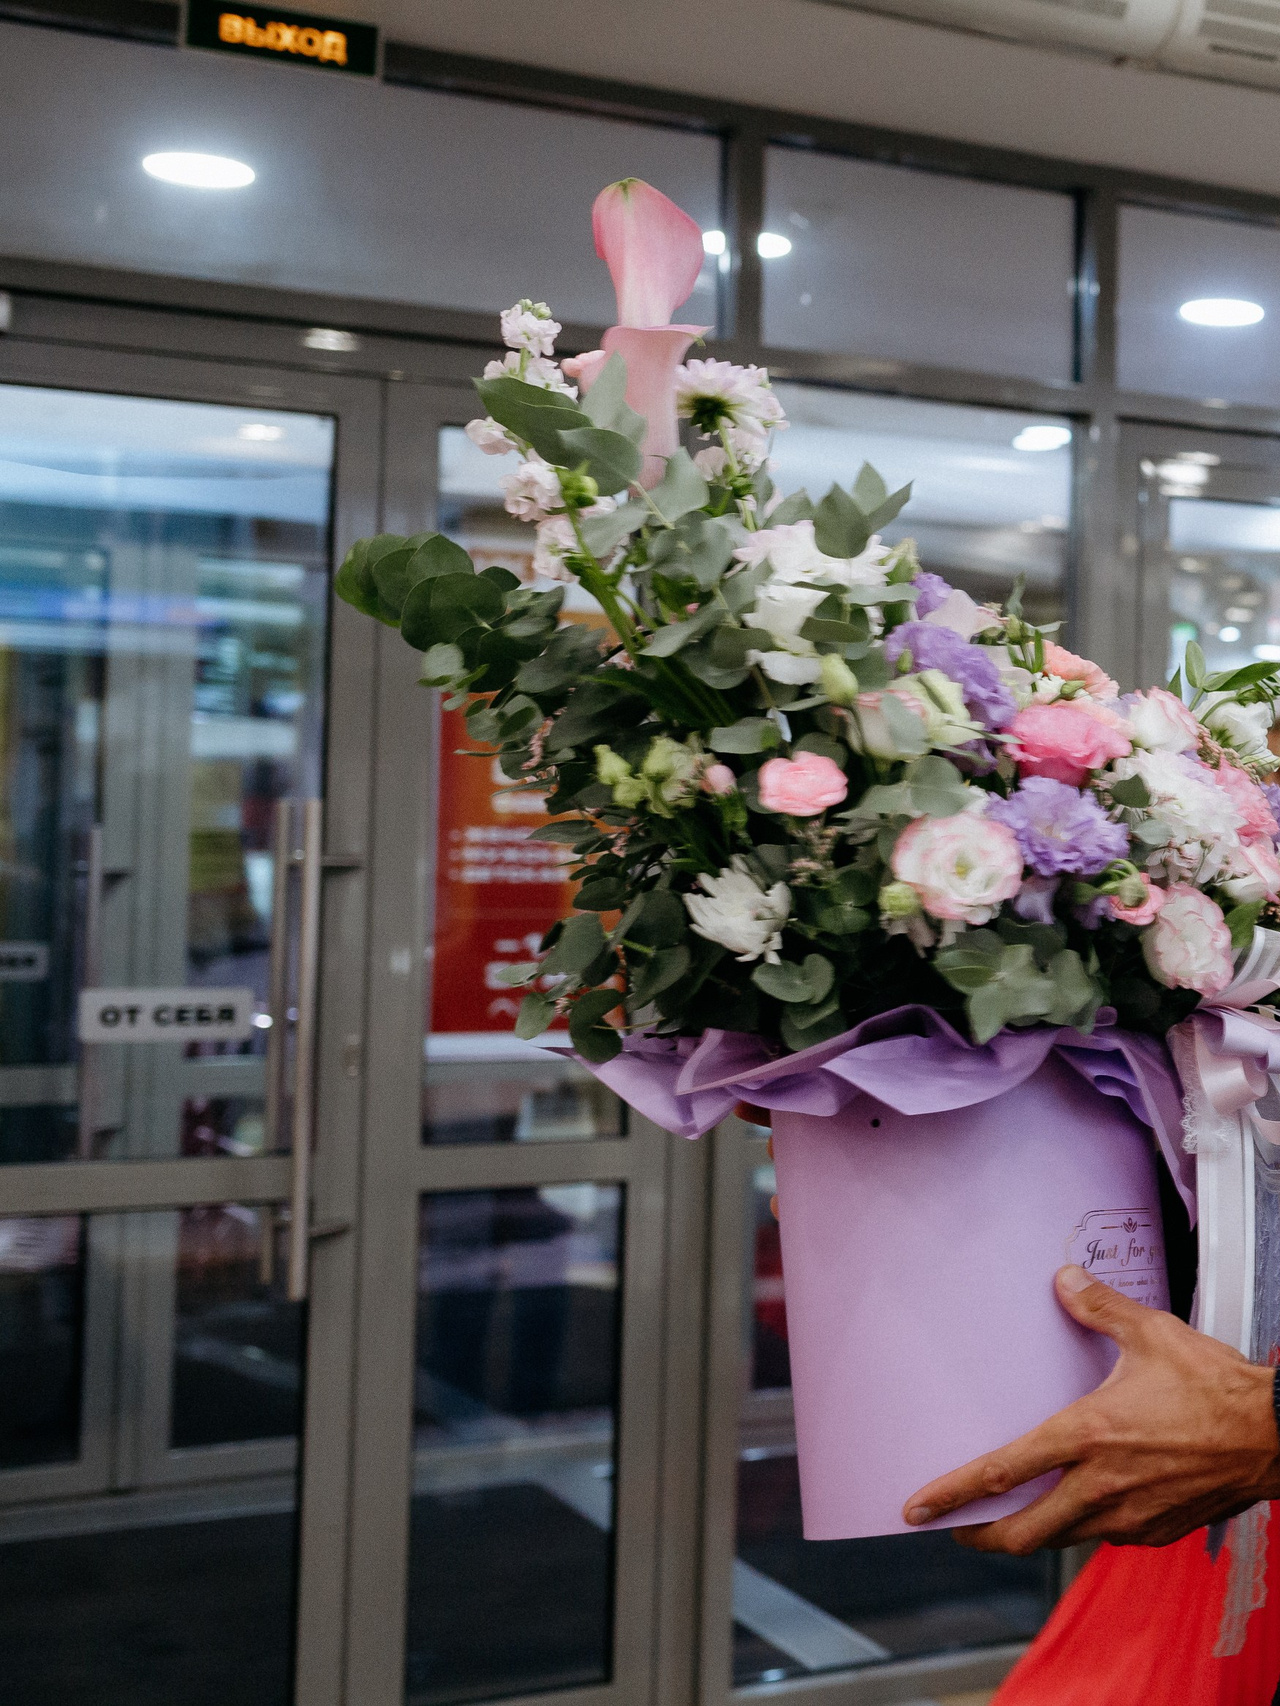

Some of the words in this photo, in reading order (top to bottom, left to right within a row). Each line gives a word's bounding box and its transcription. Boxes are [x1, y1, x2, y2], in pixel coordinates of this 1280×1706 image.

[218, 12, 348, 66] ВЫХОД
[99, 1004, 141, 1027] ОТ
[153, 1004, 236, 1026] СЕБЯ
[1082, 1239, 1119, 1269] Just
[1121, 1238, 1145, 1266] for
